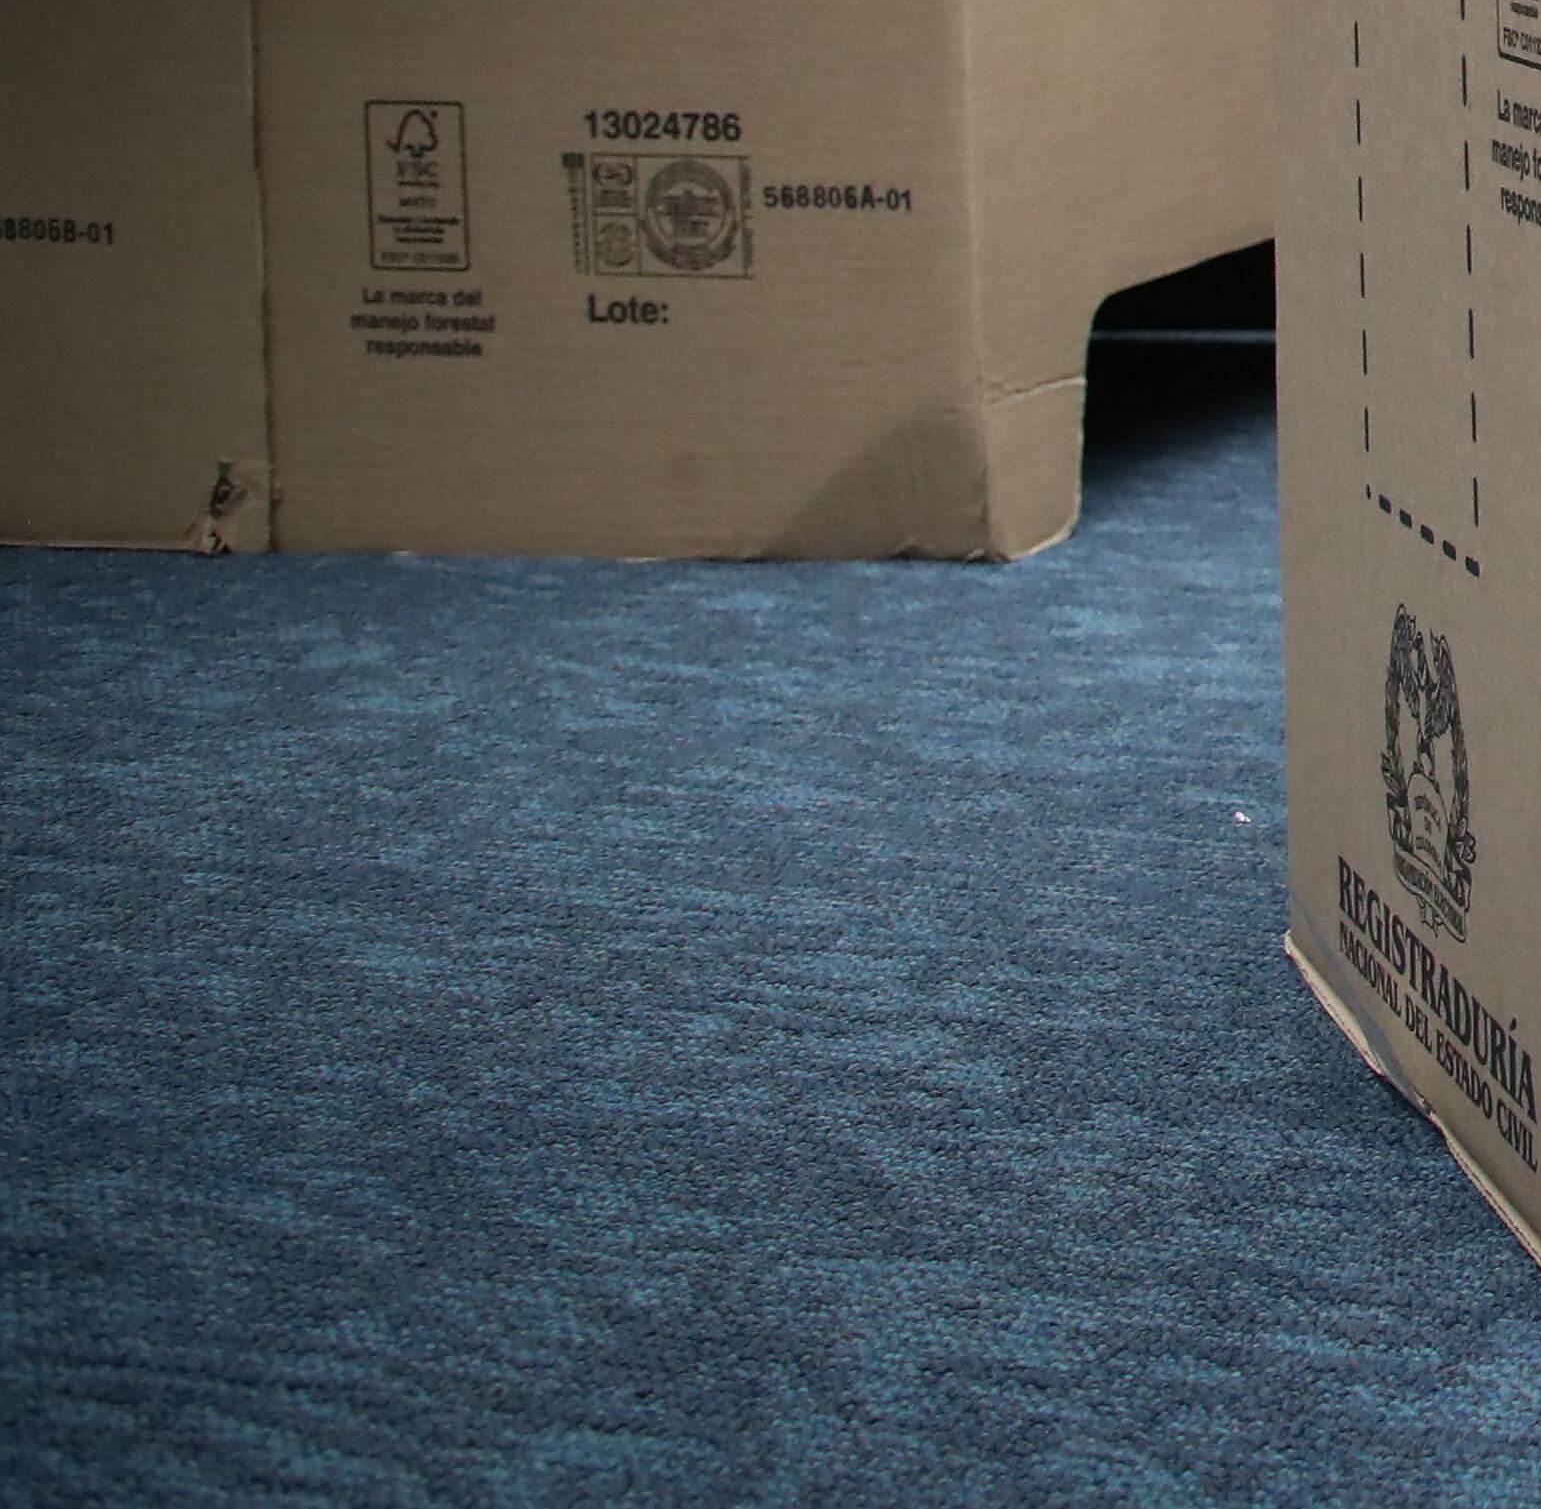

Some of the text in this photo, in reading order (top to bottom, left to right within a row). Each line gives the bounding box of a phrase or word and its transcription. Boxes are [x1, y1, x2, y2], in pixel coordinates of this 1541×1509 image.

[1497, 89, 1510, 123] La
[584, 109, 742, 142] 13024786
[1491, 139, 1531, 182] manejo
[763, 183, 914, 212] 568806A-01
[0, 216, 114, 246] 8806B-01
[586, 294, 670, 325] Lote:
[1337, 854, 1538, 1125] REGISTRADURÍA
[1339, 920, 1402, 1018] NACIONAL
[1404, 992, 1433, 1054] DEL
[1435, 1027, 1493, 1120] ESTADO
[1496, 1097, 1538, 1174] CIVIL
